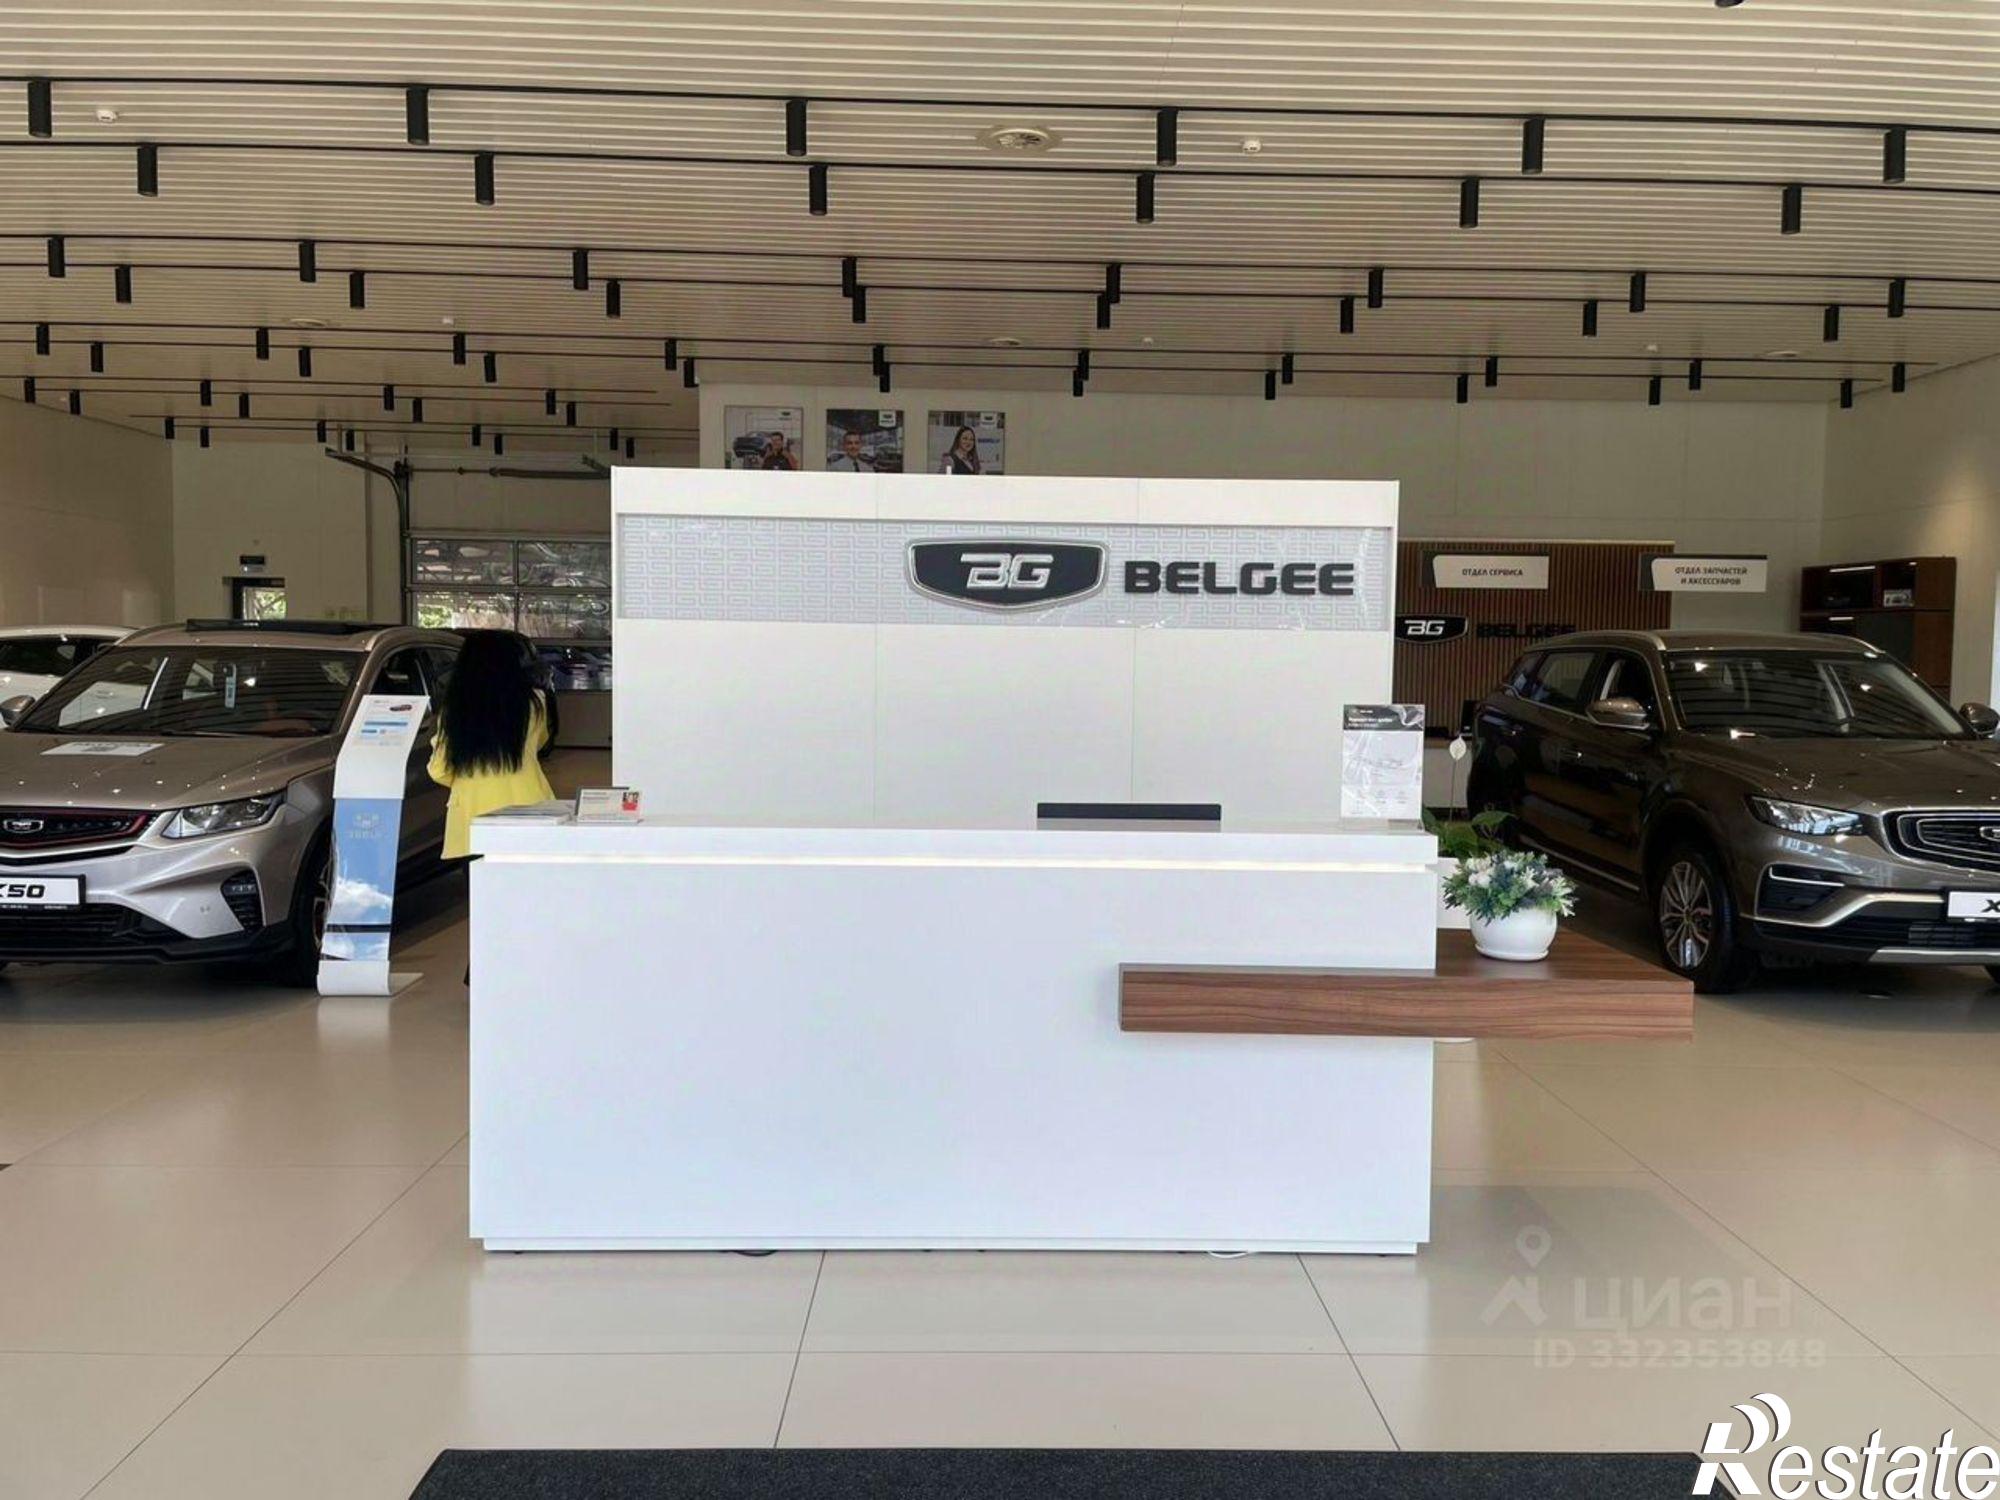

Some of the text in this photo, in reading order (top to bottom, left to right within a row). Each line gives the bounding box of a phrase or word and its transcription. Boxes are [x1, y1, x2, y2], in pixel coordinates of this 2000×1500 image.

[1461, 568, 1524, 577] ОТДЕЛ СЕРВИСА
[1674, 565, 1748, 576] ОТДЕЛ ЗАПЧАСТЕЙ
[1124, 561, 1355, 595] BELGEE
[1680, 577, 1742, 586] И АКСЕССУАРОВ
[1476, 623, 1577, 638] BELGEE
